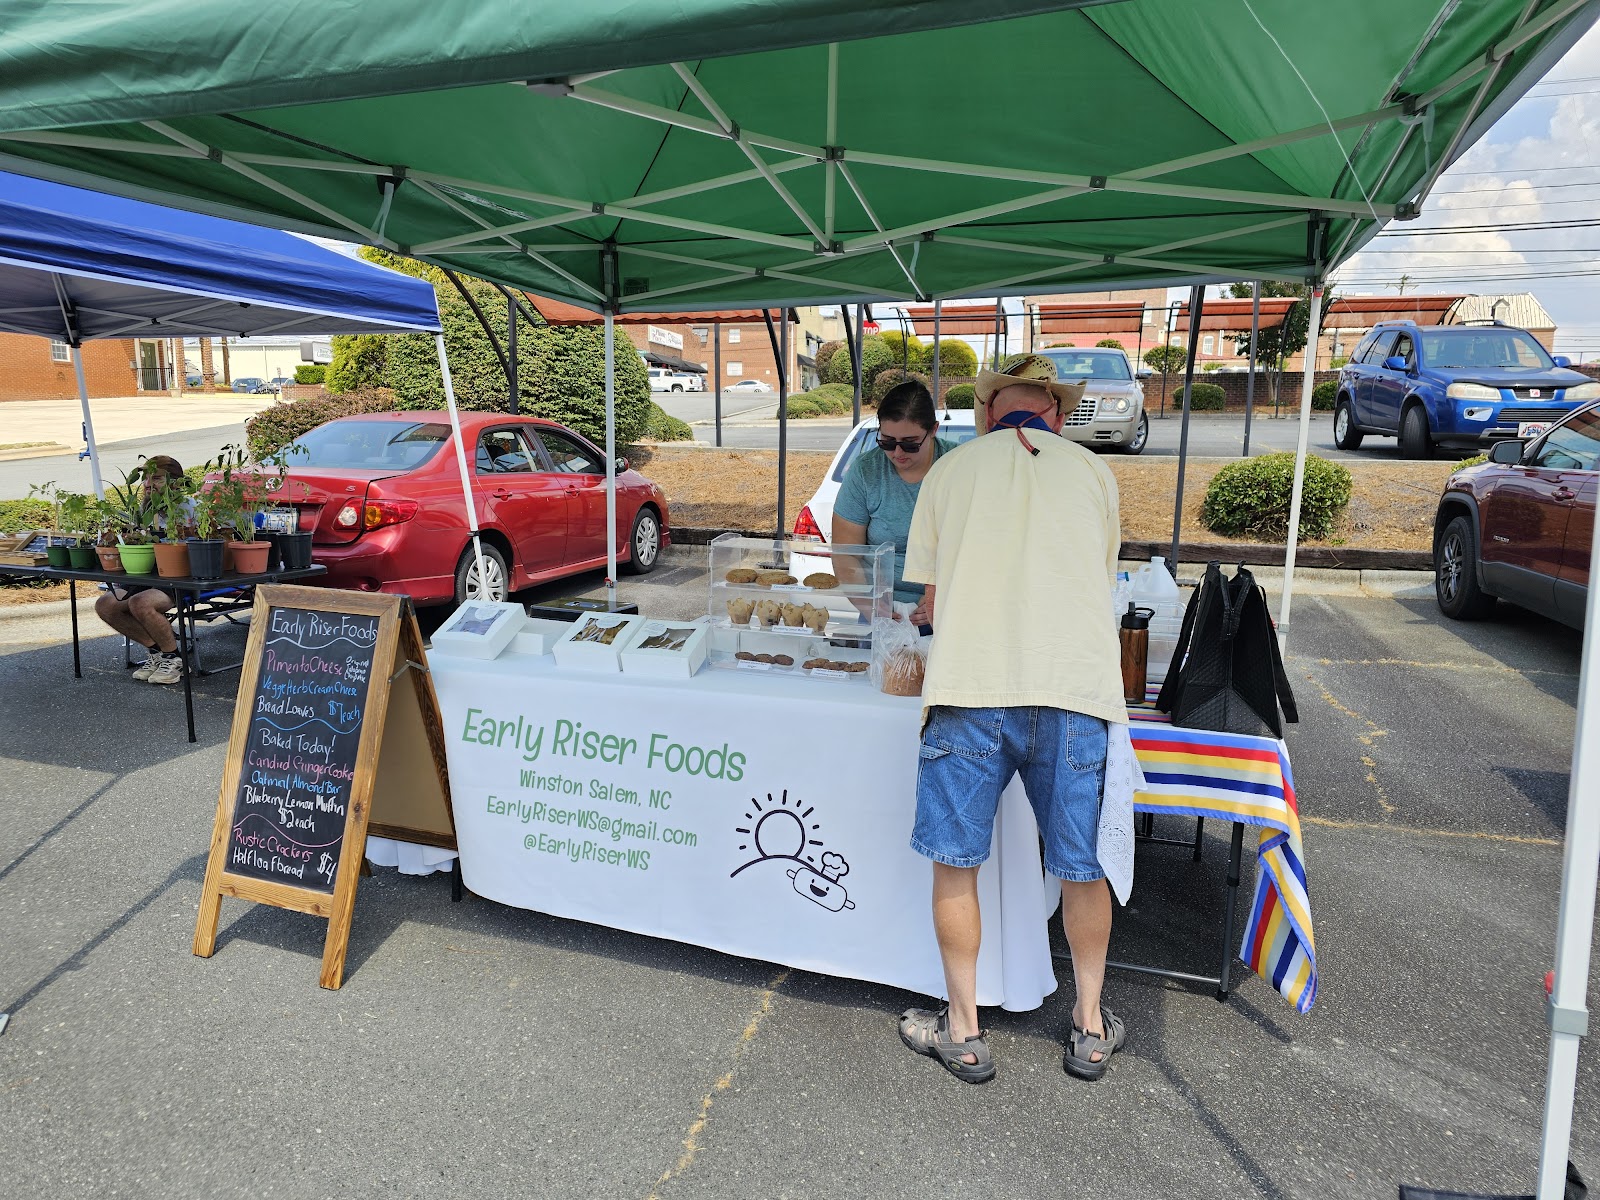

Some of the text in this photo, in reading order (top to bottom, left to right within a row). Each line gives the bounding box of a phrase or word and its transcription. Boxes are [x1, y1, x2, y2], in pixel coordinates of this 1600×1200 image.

[272, 610, 378, 644] Early Riser Foods
[257, 695, 284, 715] Bread
[286, 697, 315, 718] Loaves
[249, 750, 291, 771] Candied
[259, 728, 336, 764] Baked Today!
[462, 708, 747, 782] Early Riser Foods
[243, 785, 284, 808] Blueberry
[285, 790, 314, 811] Lemon
[292, 774, 325, 794] Almond
[325, 781, 342, 794] Bar
[520, 769, 672, 810] Winston Salem, NC
[487, 795, 697, 847] EarlyRiserWS@gmail.com
[233, 827, 313, 862] Rustic Crackers
[524, 833, 650, 871] @EarlyRiserWS
[317, 852, 337, 884] $4
